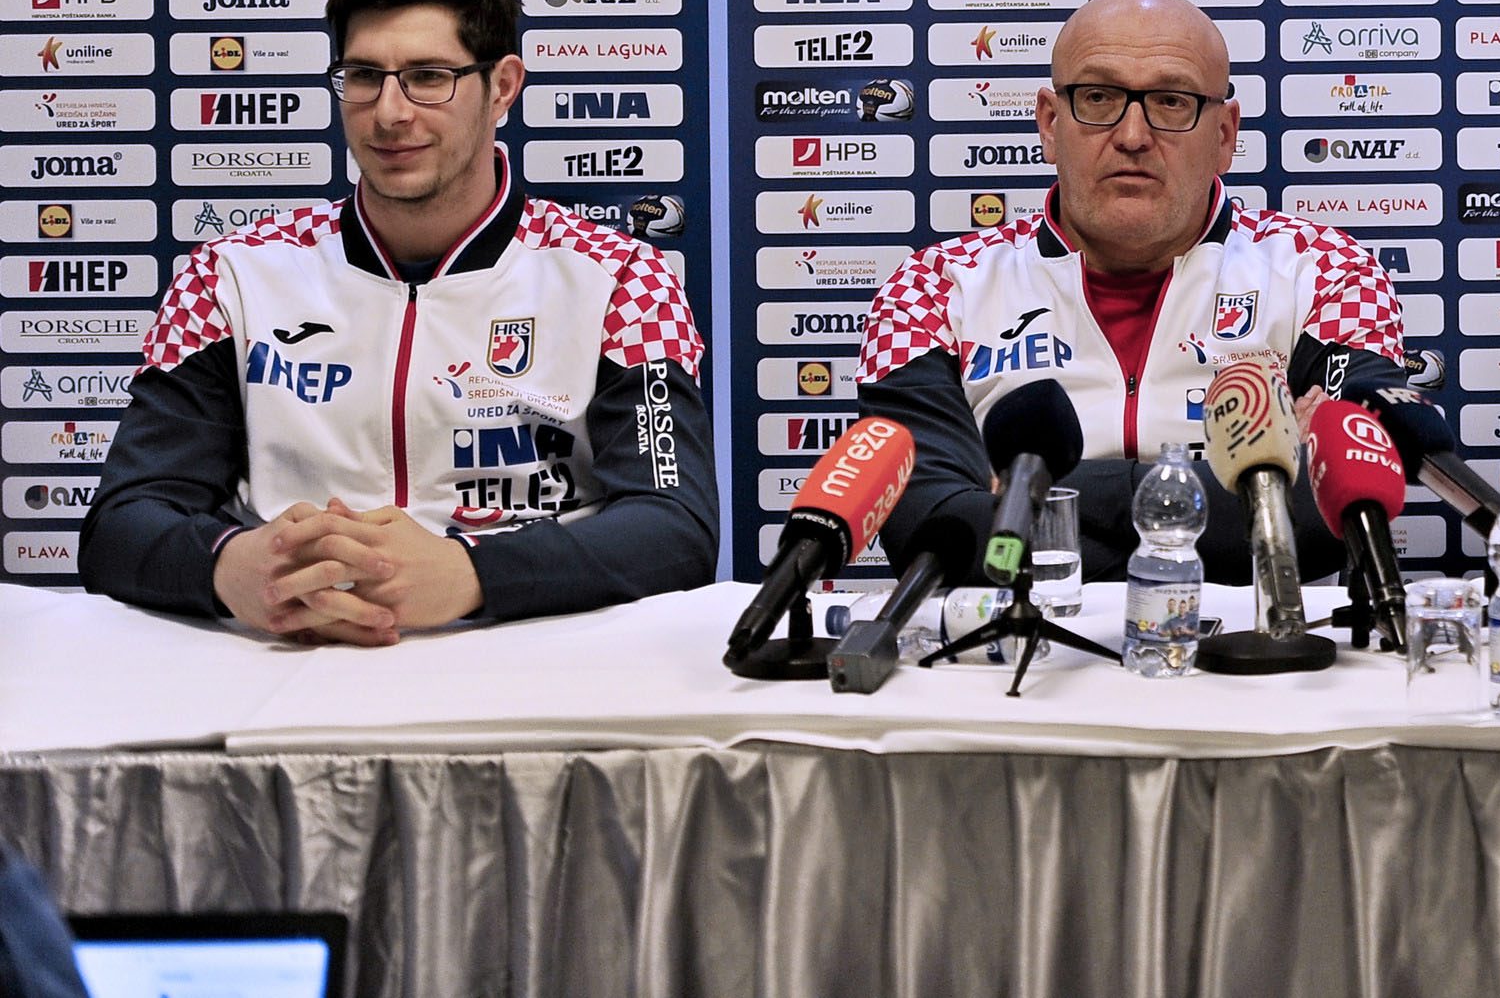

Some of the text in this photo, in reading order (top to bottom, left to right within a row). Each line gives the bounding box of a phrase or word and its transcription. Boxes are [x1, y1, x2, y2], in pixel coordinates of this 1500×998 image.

[1297, 199, 1427, 215] PLAVA LAGUNA
[1219, 294, 1255, 308] HRS
[495, 322, 530, 335] HRS
[994, 332, 1073, 374] HEP
[268, 349, 353, 404] HEP
[468, 404, 566, 427] URED ZA ŠPORT
[649, 361, 680, 489] PORSCHE
[821, 421, 897, 497] mreža
[1345, 448, 1402, 476] nova
[455, 463, 581, 511] TELE2
